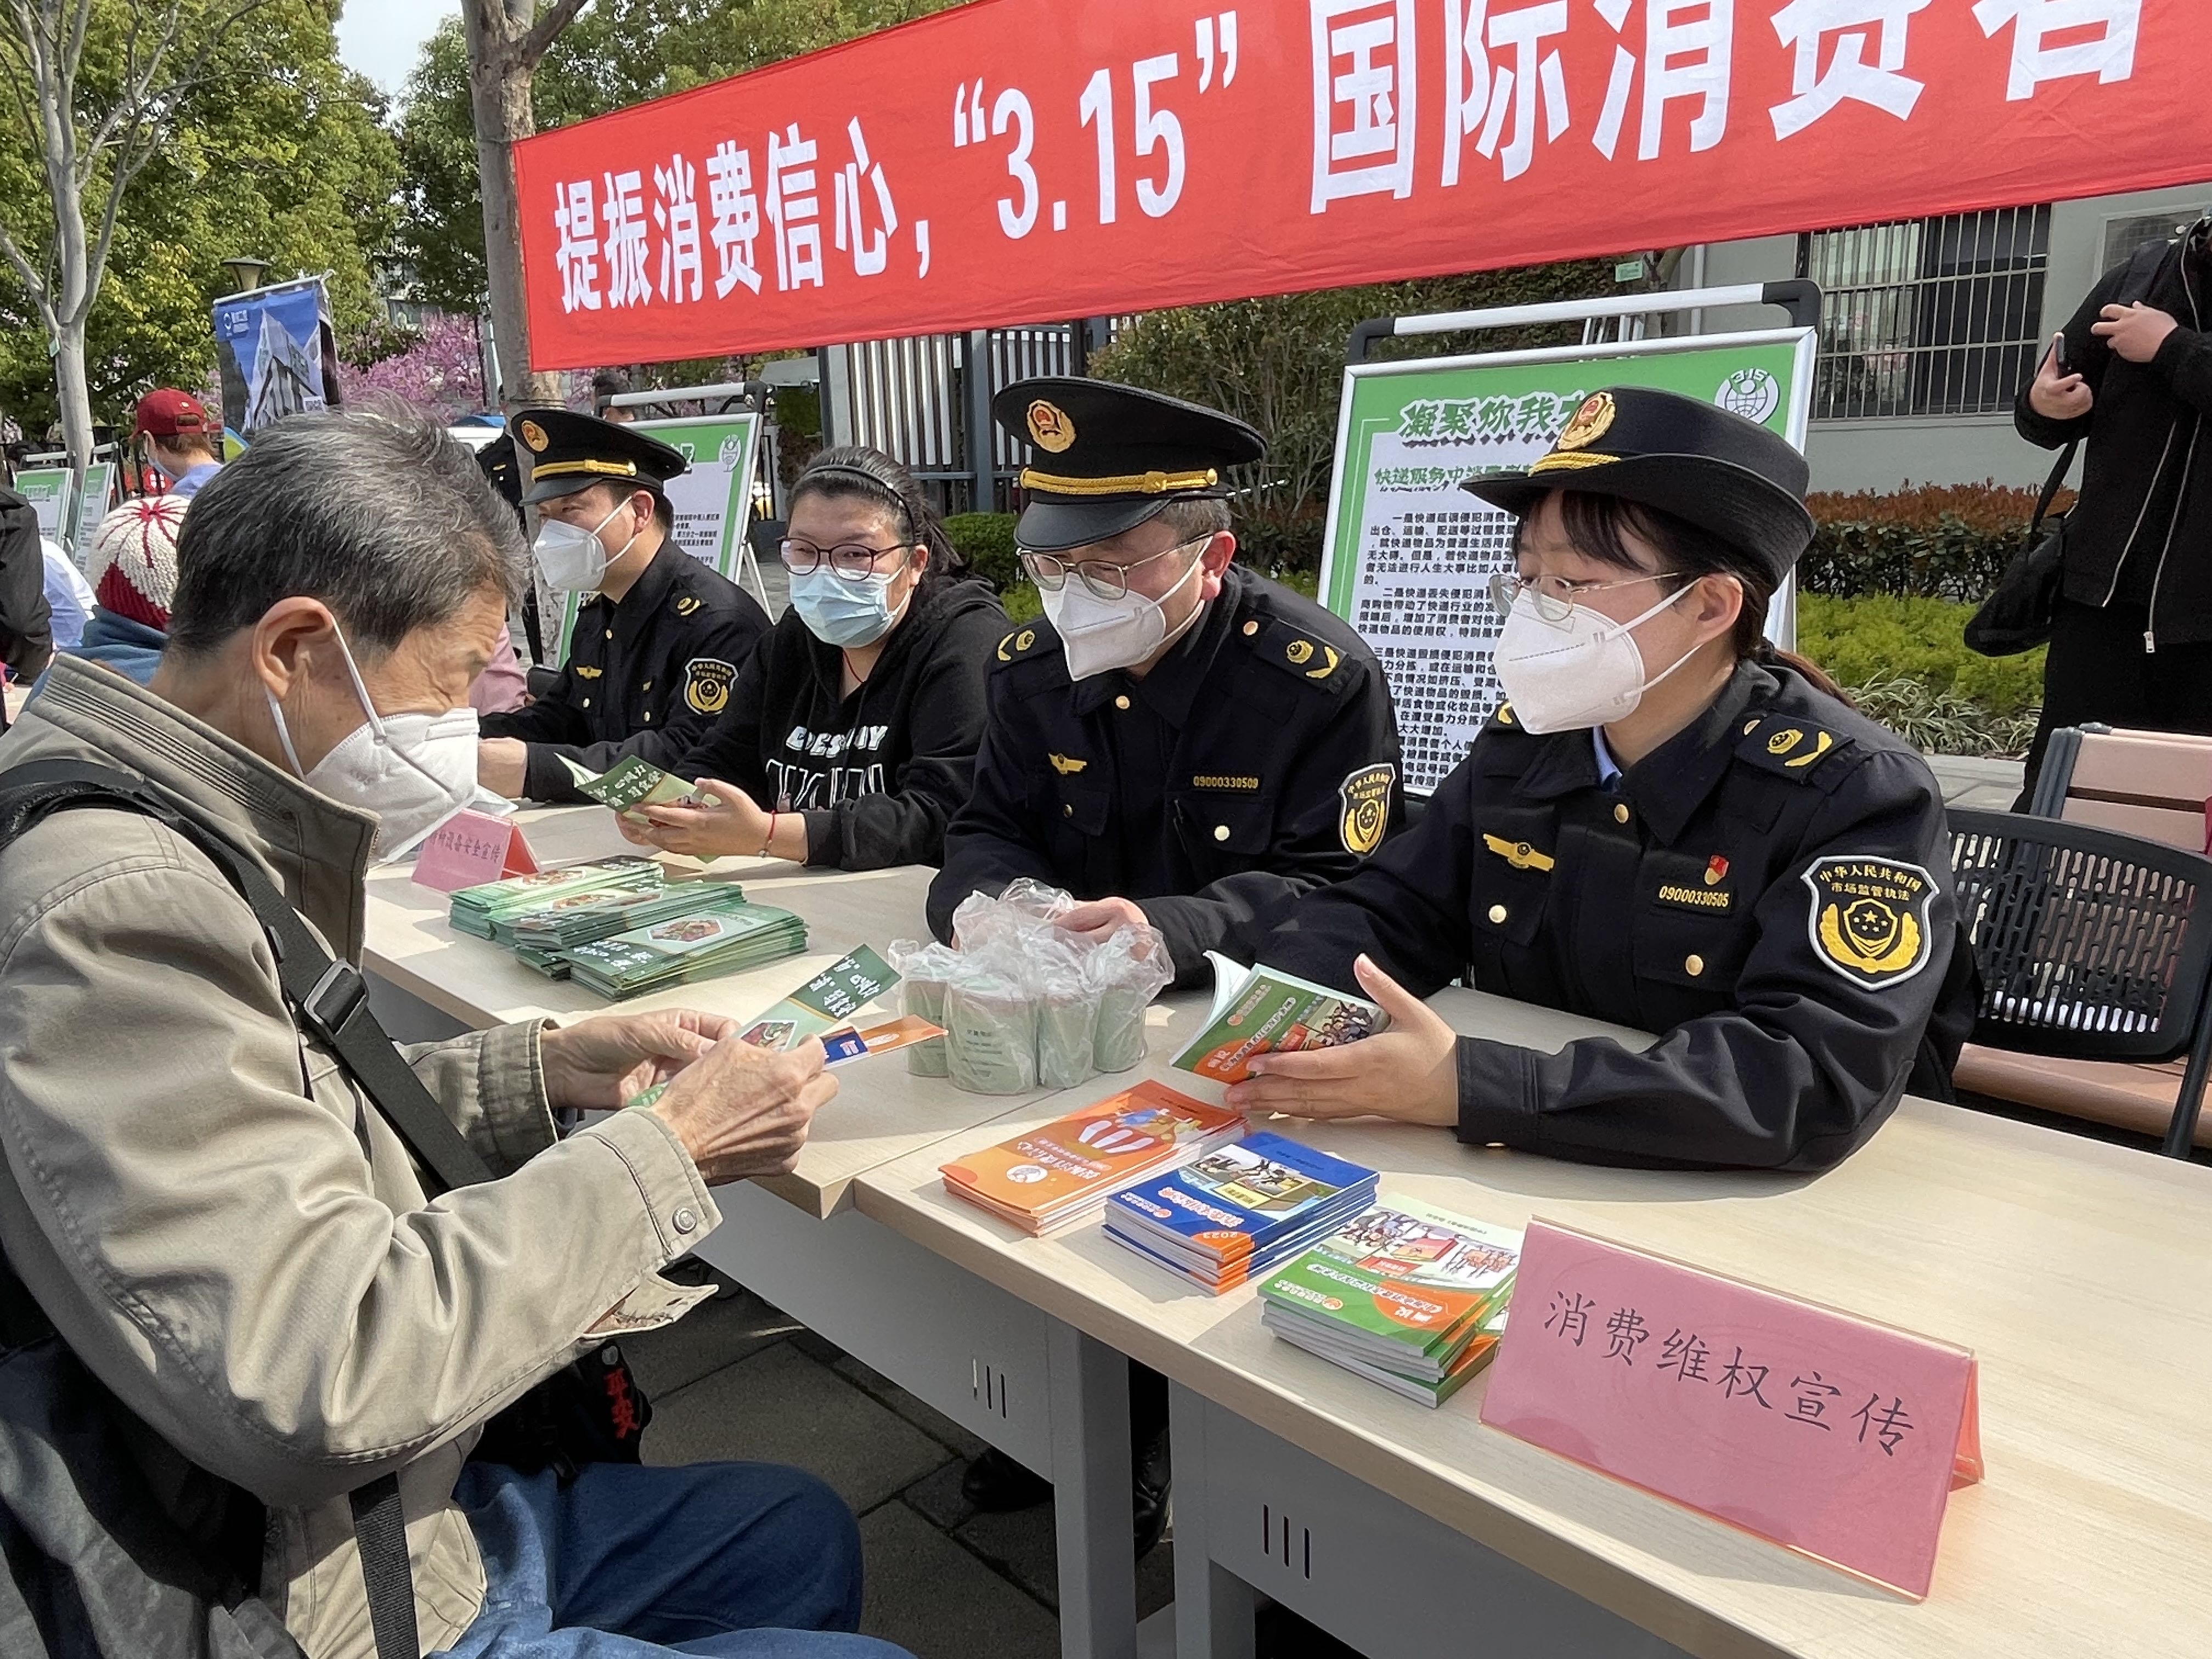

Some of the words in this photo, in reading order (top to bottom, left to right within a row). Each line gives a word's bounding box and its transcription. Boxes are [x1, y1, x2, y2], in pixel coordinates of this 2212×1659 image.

[1819, 864, 1923, 893] 中华人民共和国
[1831, 882, 1911, 901] 市场监管执法
[1543, 1289, 1915, 1457] 消费维权宣传
